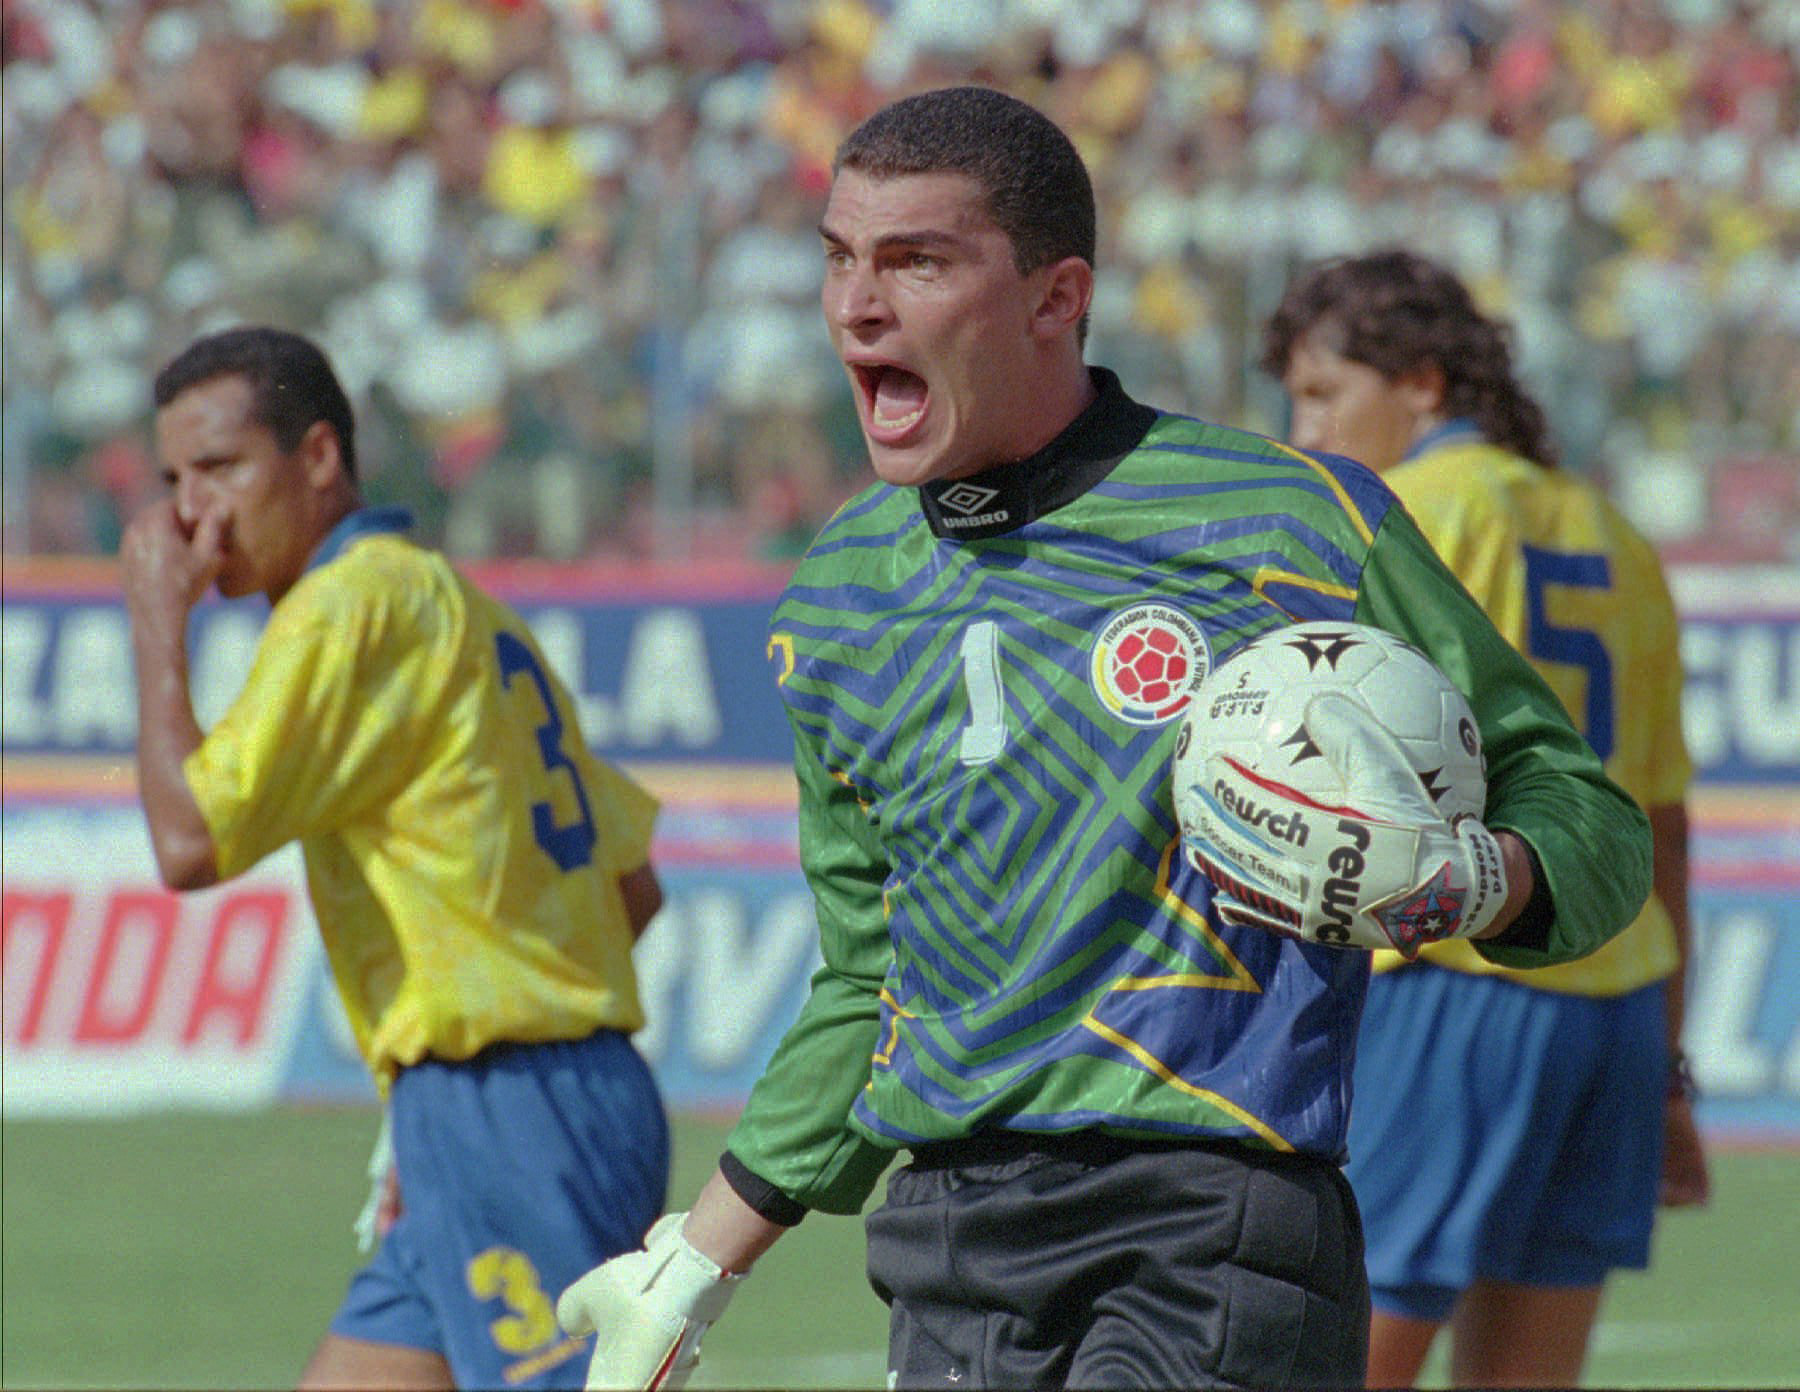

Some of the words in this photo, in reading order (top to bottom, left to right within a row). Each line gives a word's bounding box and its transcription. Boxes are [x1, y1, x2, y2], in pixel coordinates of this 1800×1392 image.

[942, 509, 1009, 529] UMBRO
[959, 621, 1009, 767] 1
[1236, 671, 1252, 689] 5
[1521, 542, 1616, 766] 5
[493, 630, 598, 873] 3
[1214, 778, 1310, 849] reusch
[1247, 852, 1293, 892] Team
[1315, 818, 1371, 948] reusc
[466, 1245, 558, 1354] 3
